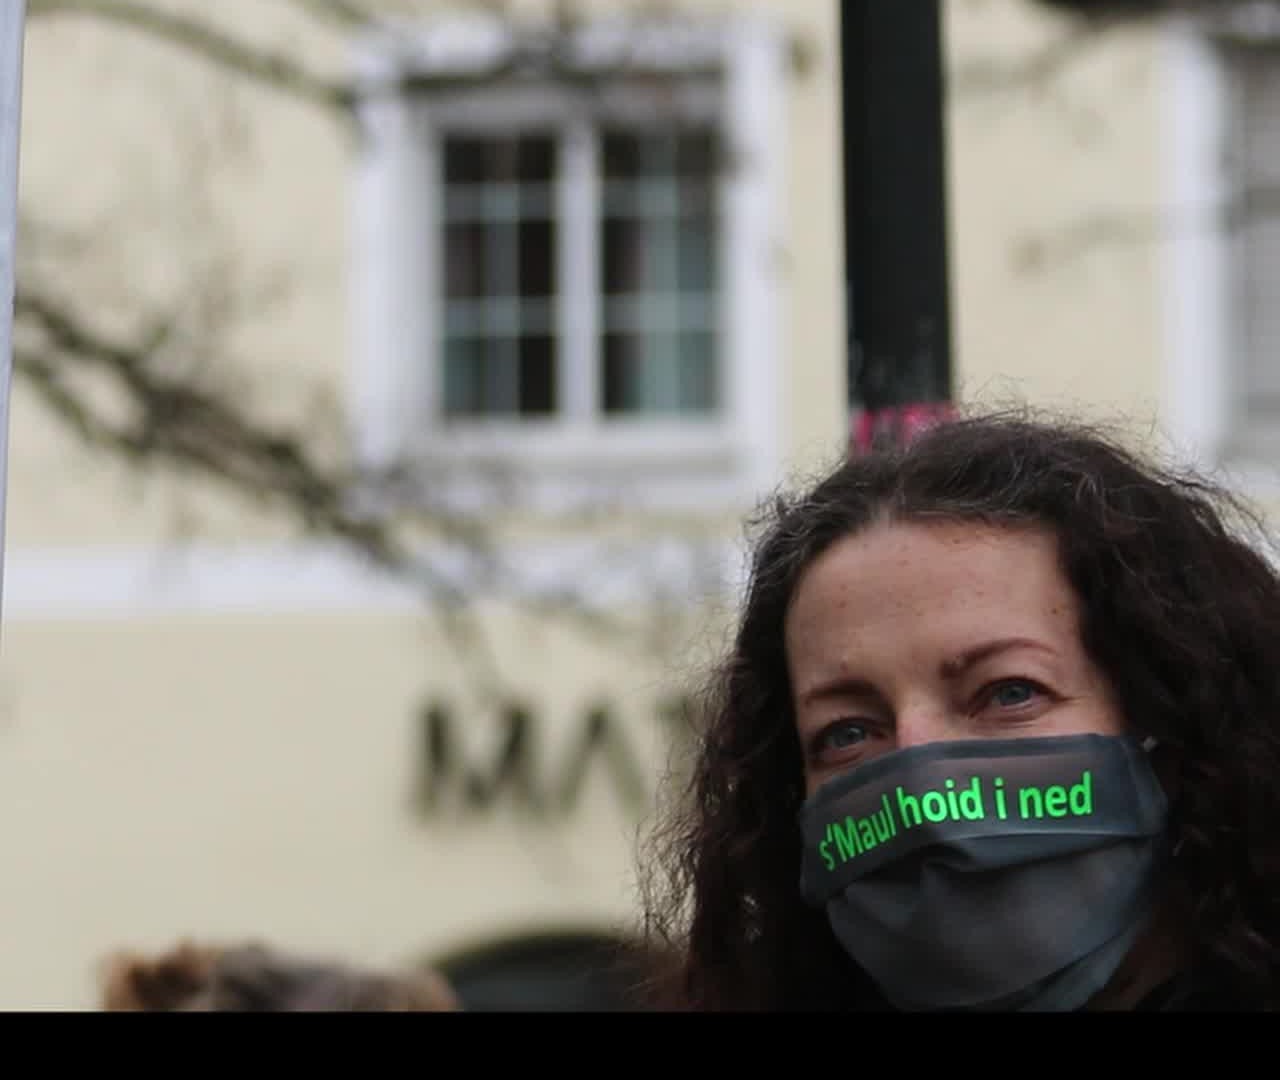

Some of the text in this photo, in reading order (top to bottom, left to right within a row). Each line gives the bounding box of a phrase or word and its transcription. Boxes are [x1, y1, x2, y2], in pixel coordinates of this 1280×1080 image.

[896, 776, 986, 829] hoid
[994, 776, 1008, 820] i
[1018, 770, 1093, 819] ned
